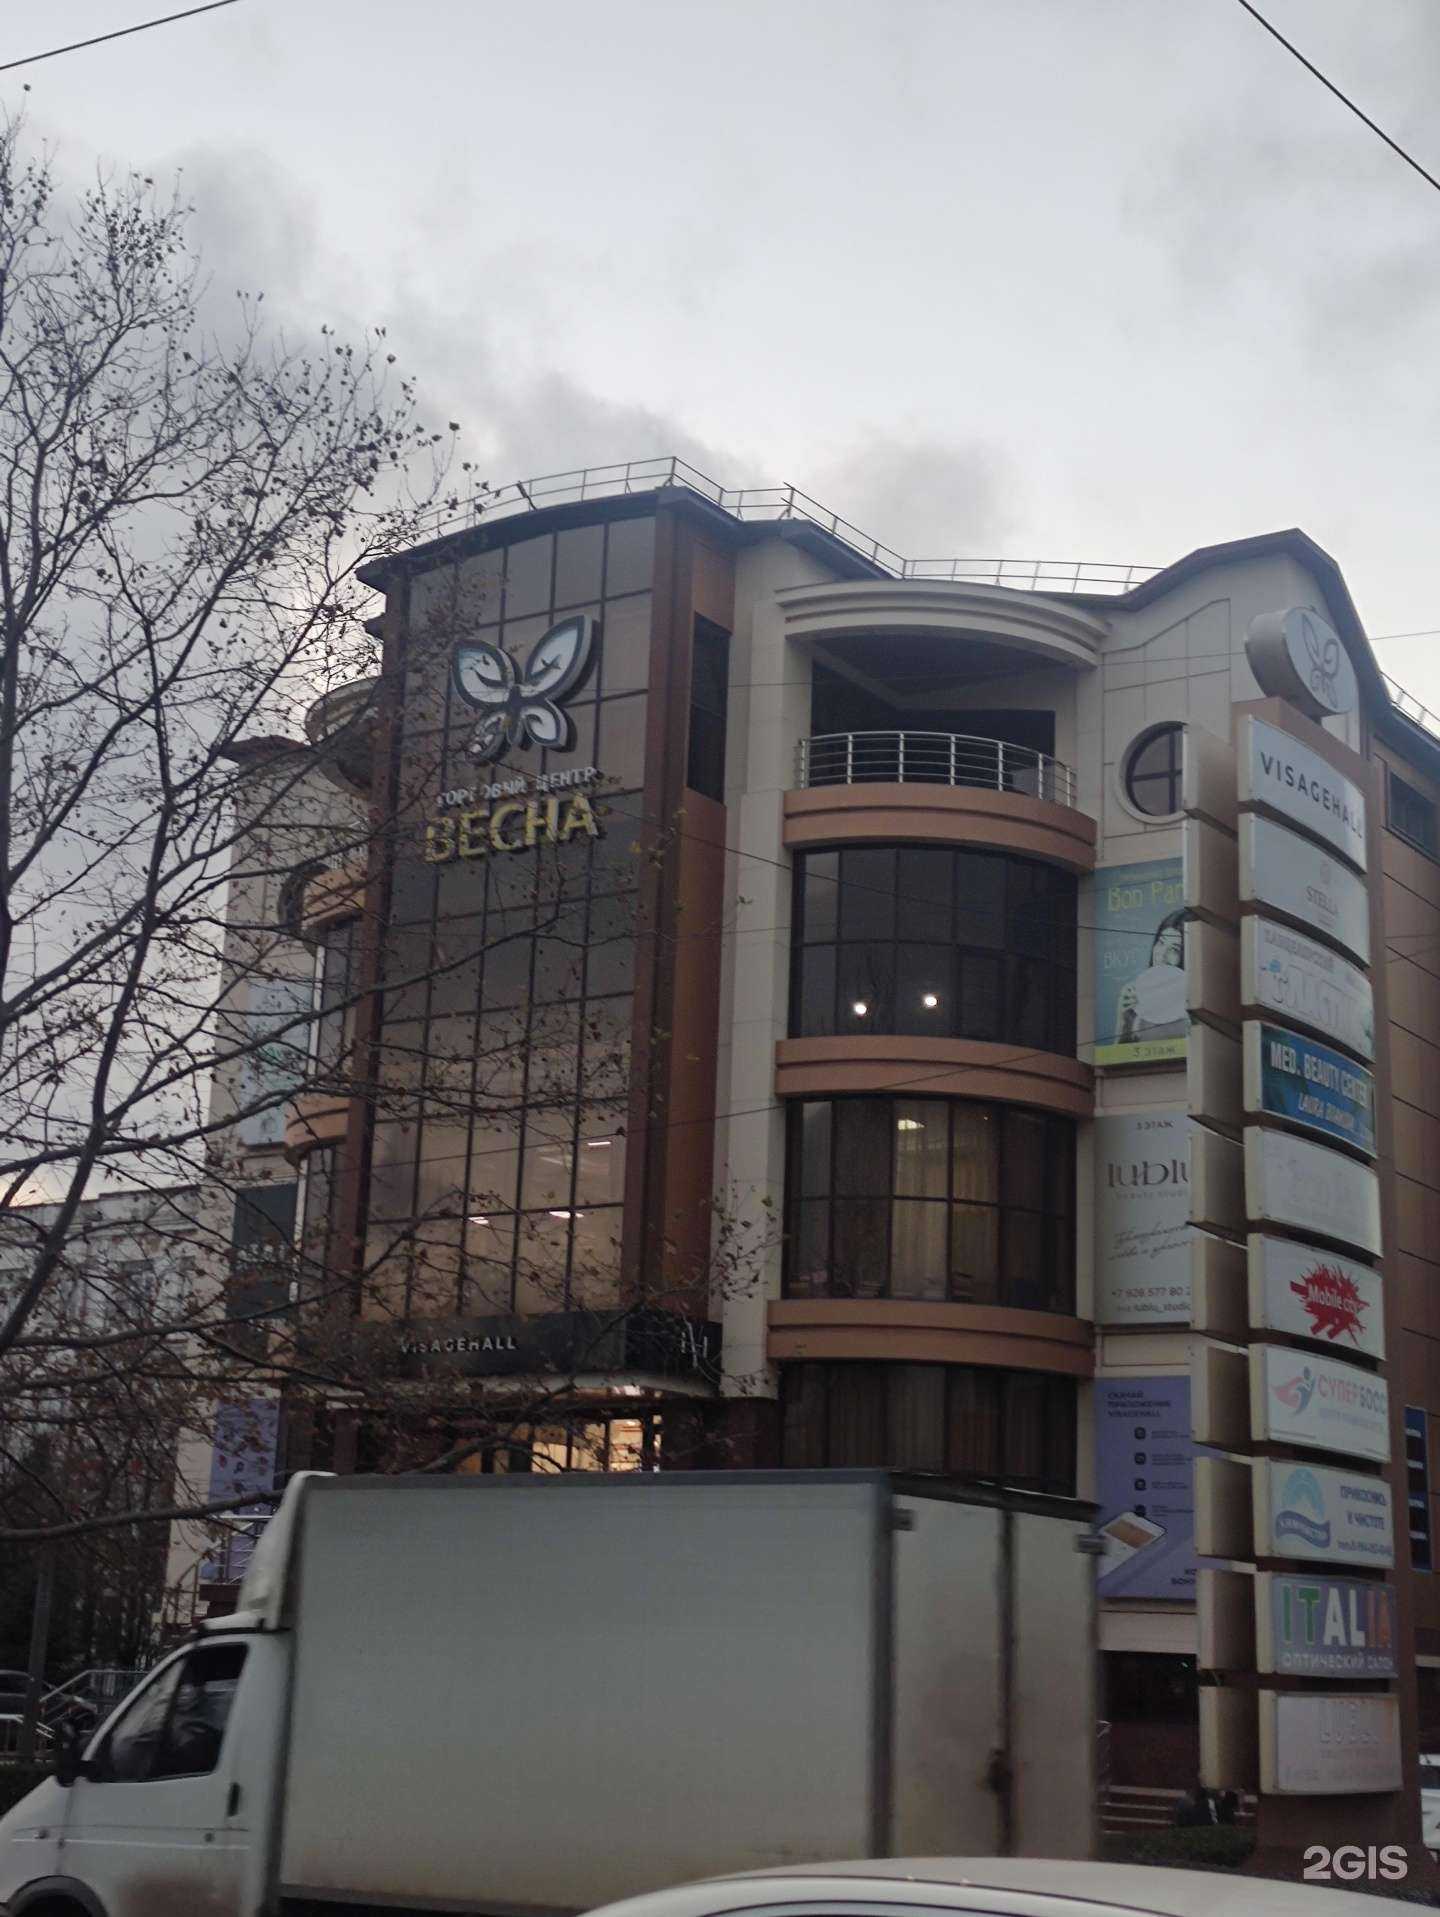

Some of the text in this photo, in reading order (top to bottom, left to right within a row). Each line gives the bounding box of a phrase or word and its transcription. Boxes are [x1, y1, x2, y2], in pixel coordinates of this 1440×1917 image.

[424, 792, 598, 863] ВЕСНА
[1260, 751, 1363, 840] VISAGEHALL
[1107, 887, 1144, 912] Bon
[1280, 1583, 1393, 1648] ITALIA
[1281, 1651, 1366, 1671] ОПТИЧЕСКИЙ
